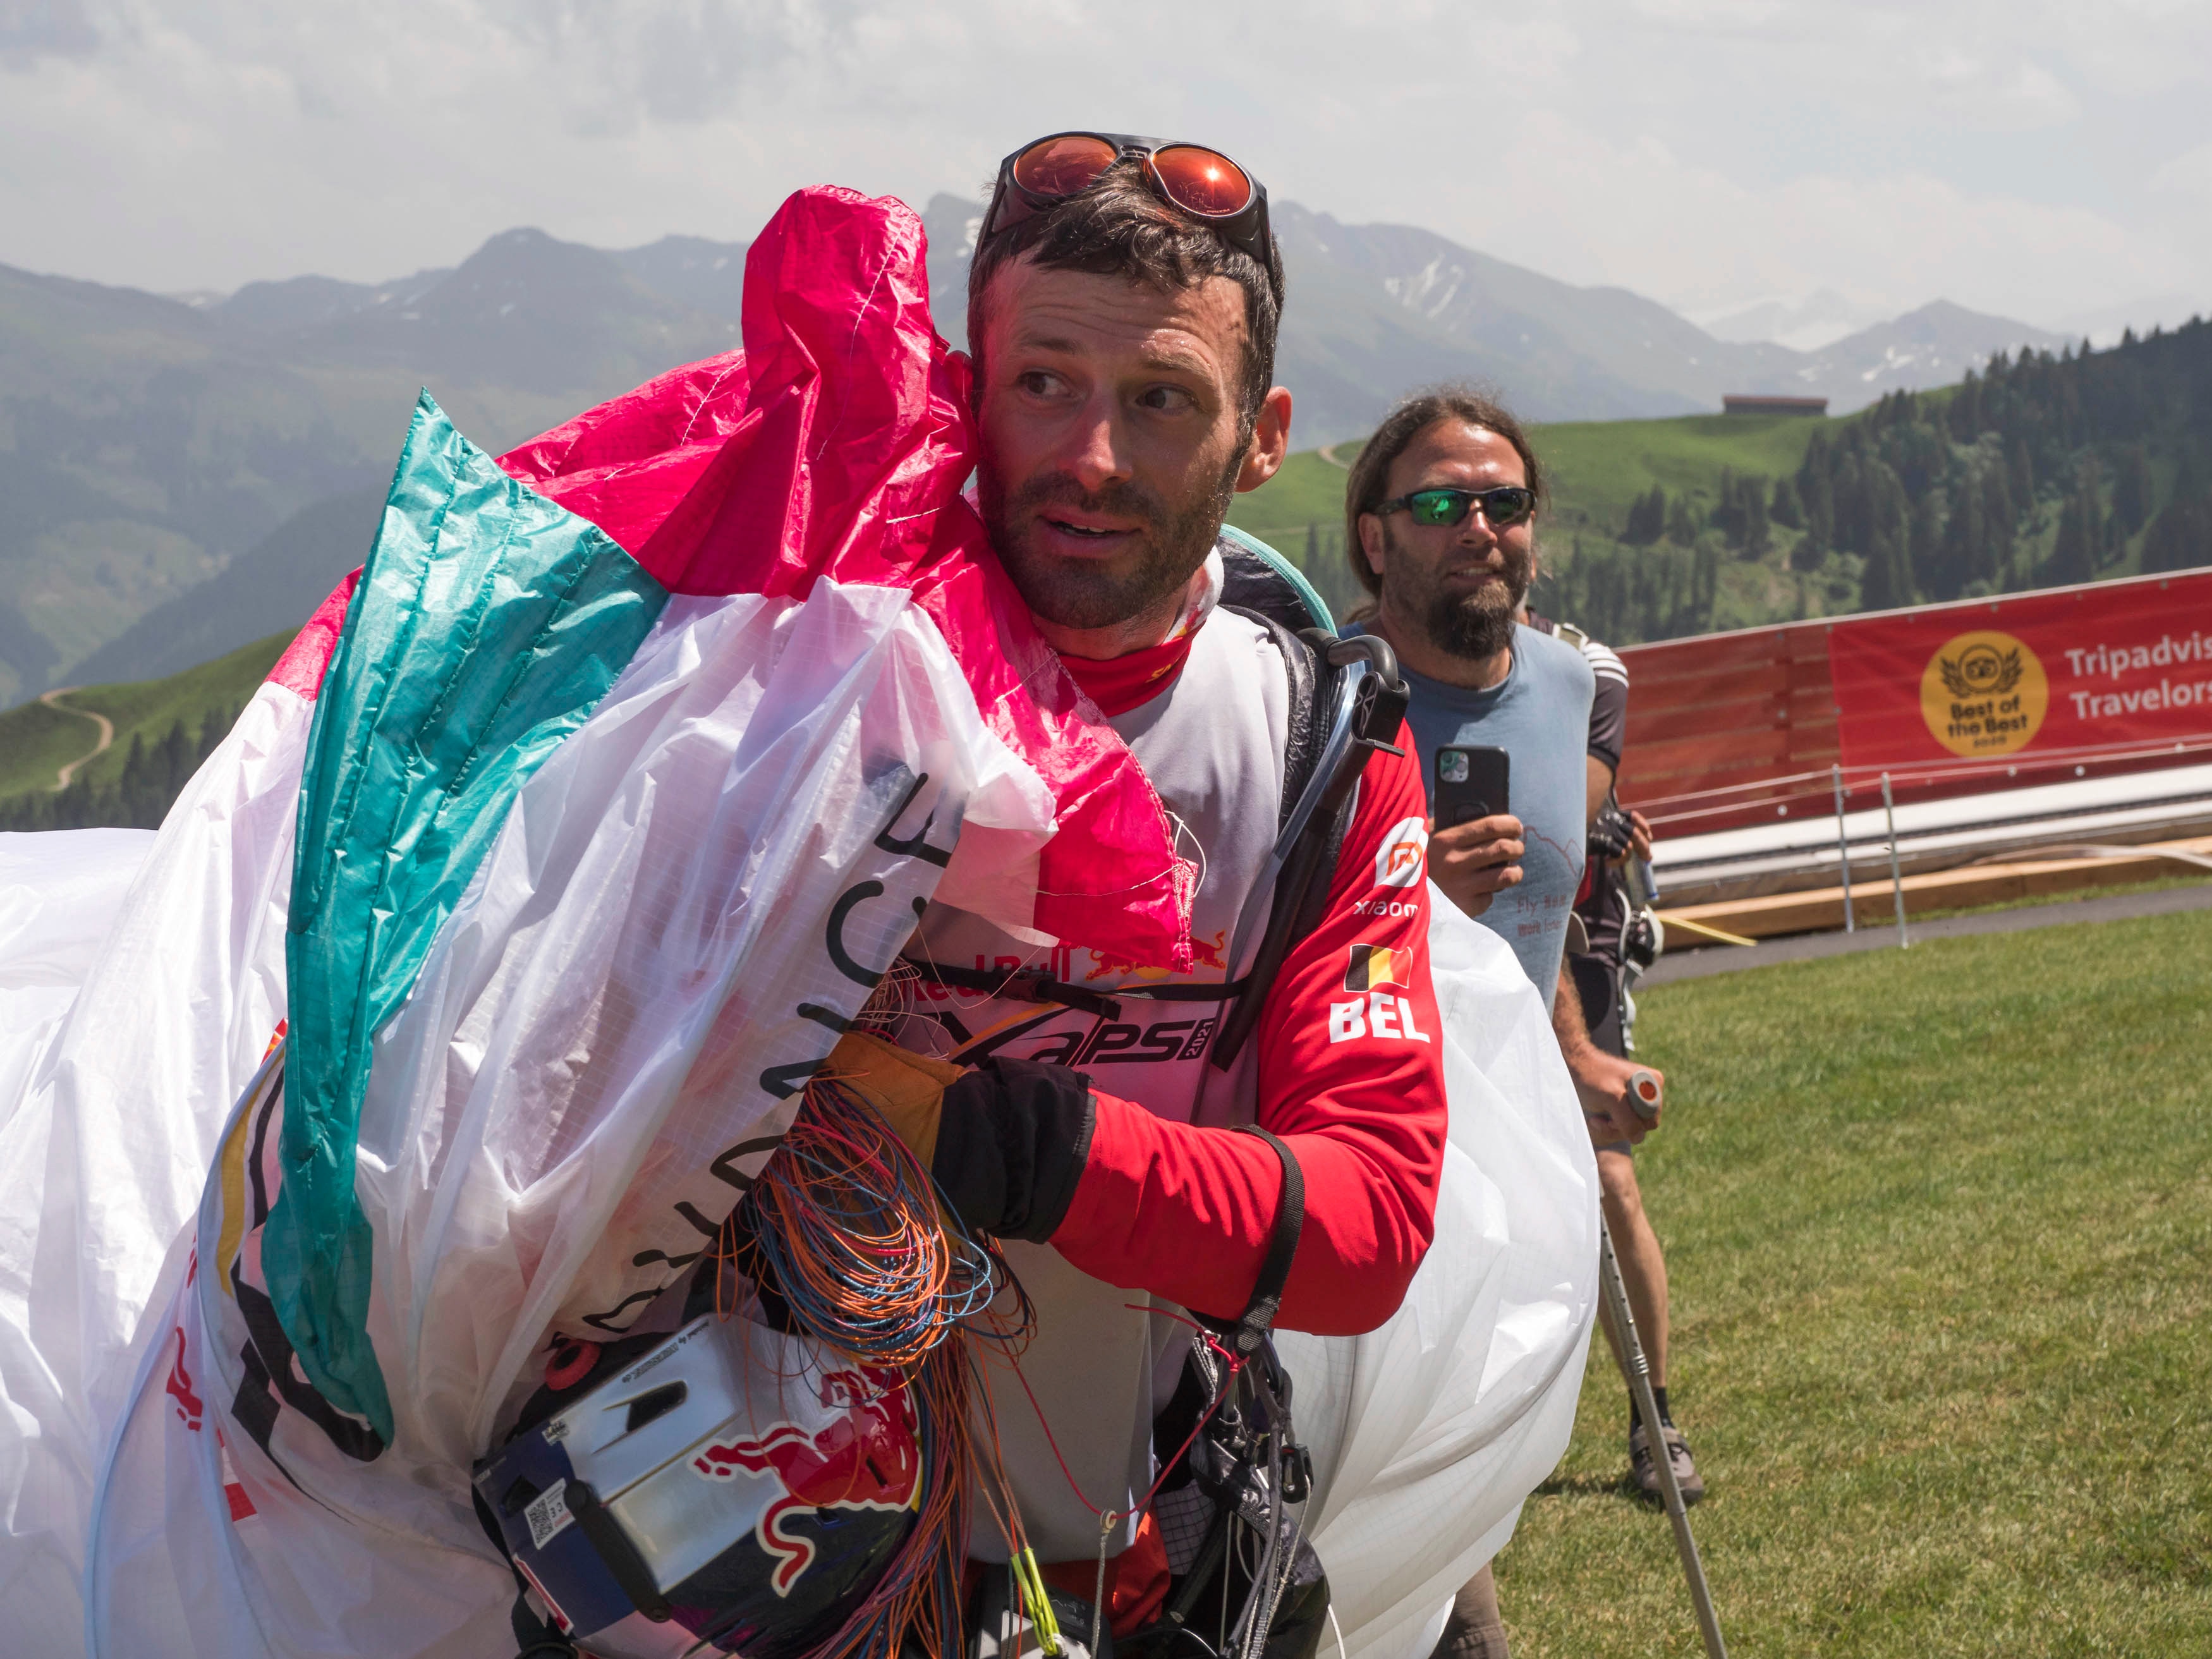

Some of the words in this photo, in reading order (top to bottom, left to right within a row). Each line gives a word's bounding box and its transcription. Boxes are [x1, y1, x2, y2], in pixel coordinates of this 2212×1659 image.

[2064, 630, 2212, 681] Tripadvis
[1950, 700, 1993, 719] Best
[2000, 694, 2019, 713] of
[1947, 721, 1981, 738] the
[1985, 714, 2027, 734] Best
[1329, 992, 1431, 1044] BEL
[1185, 1021, 1214, 1057] 2021
